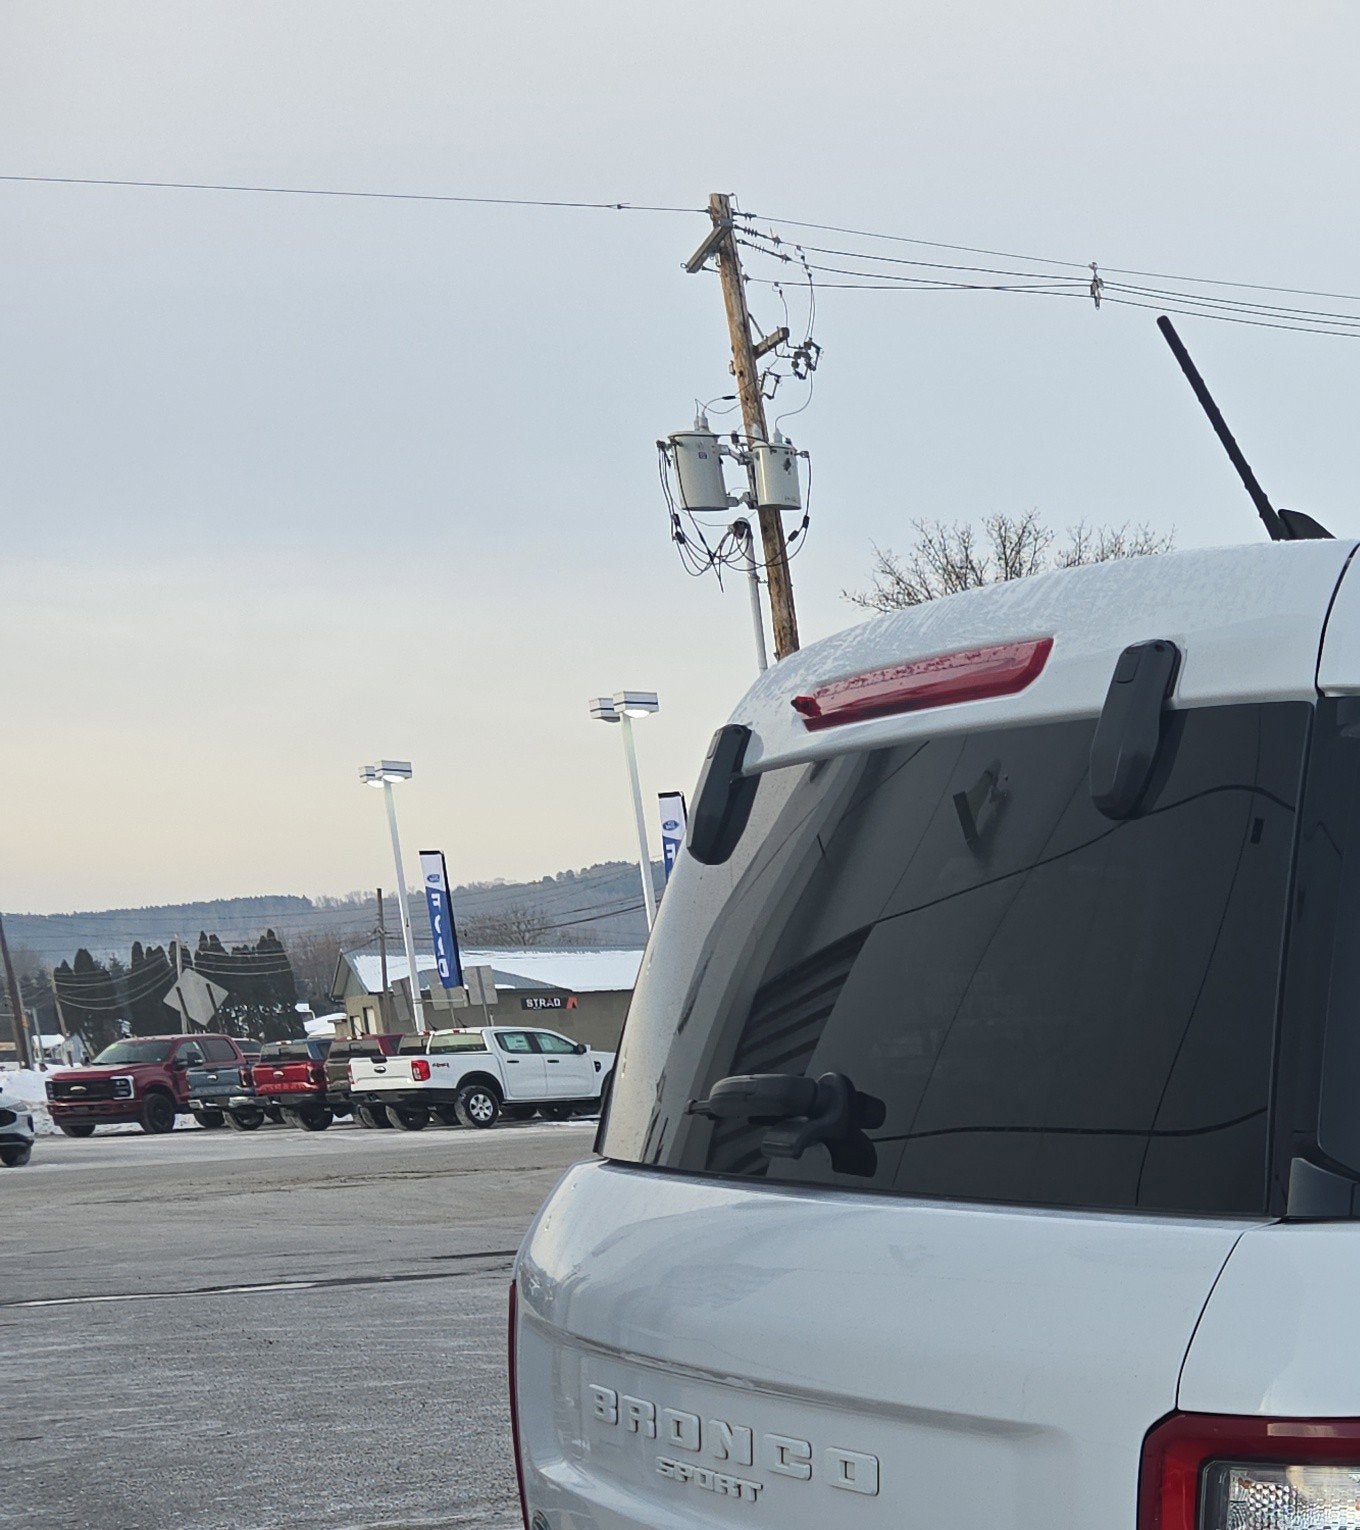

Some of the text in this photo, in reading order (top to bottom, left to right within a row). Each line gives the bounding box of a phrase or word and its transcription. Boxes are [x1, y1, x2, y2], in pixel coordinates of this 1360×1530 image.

[526, 998, 561, 1008] STRAD
[589, 1384, 879, 1496] BRONCO
[656, 1456, 763, 1502] SPORT
